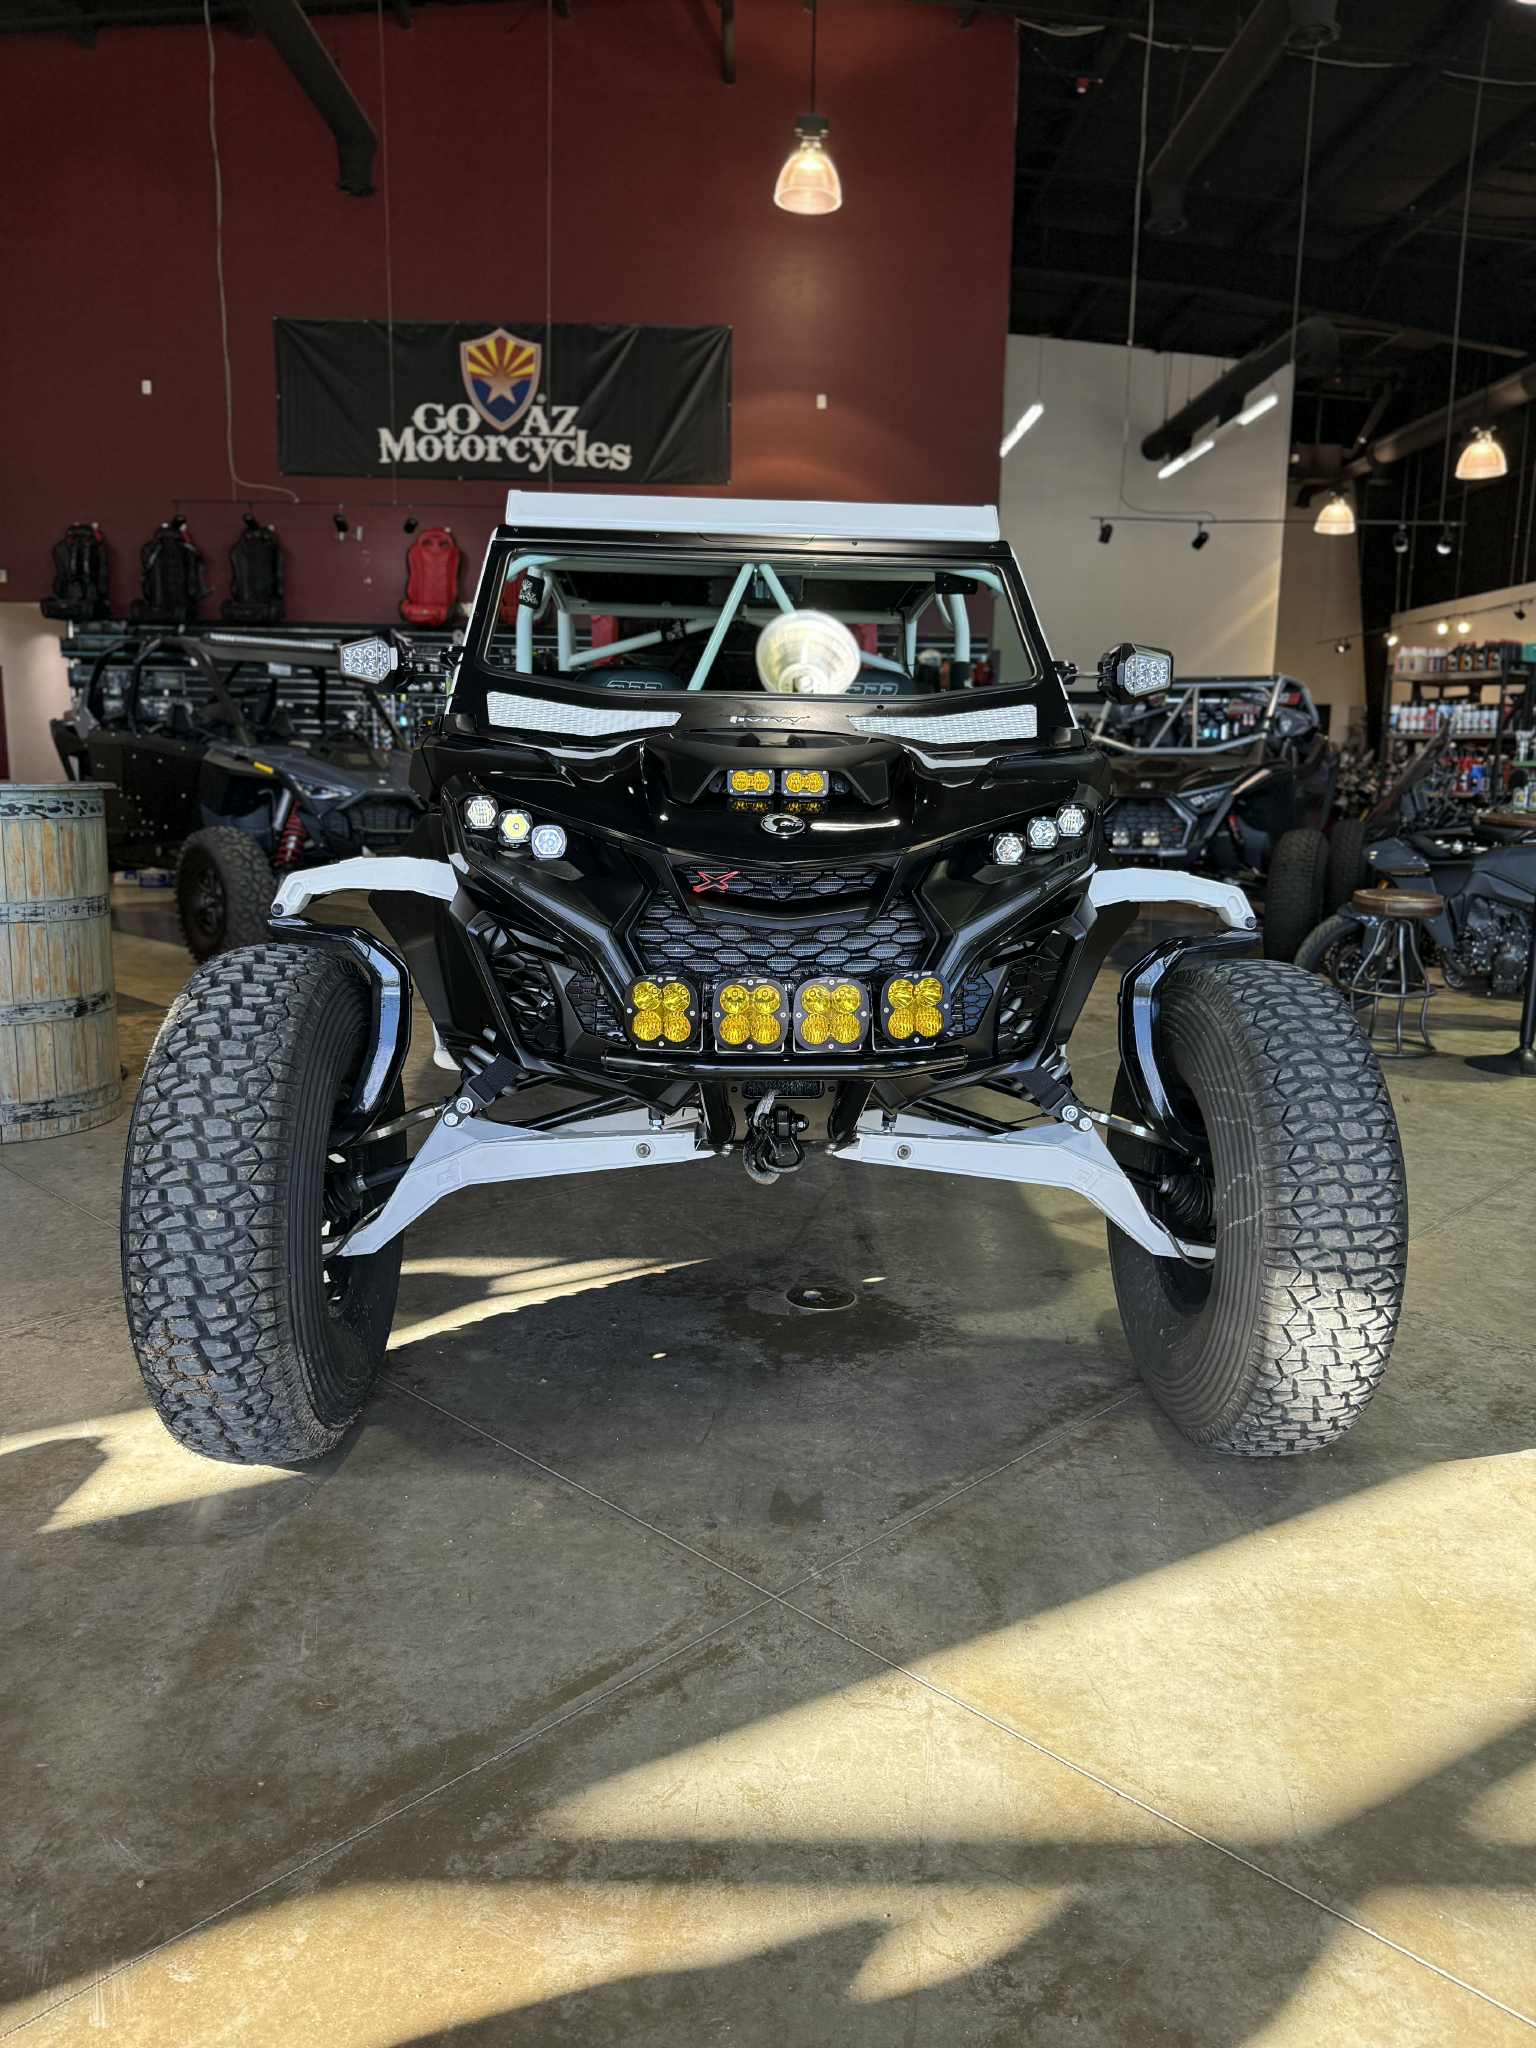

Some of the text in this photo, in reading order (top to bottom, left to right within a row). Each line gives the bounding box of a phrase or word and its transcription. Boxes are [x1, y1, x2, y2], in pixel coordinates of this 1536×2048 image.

[412, 403, 580, 437] GO AZ
[378, 426, 632, 473] Motorcycles
